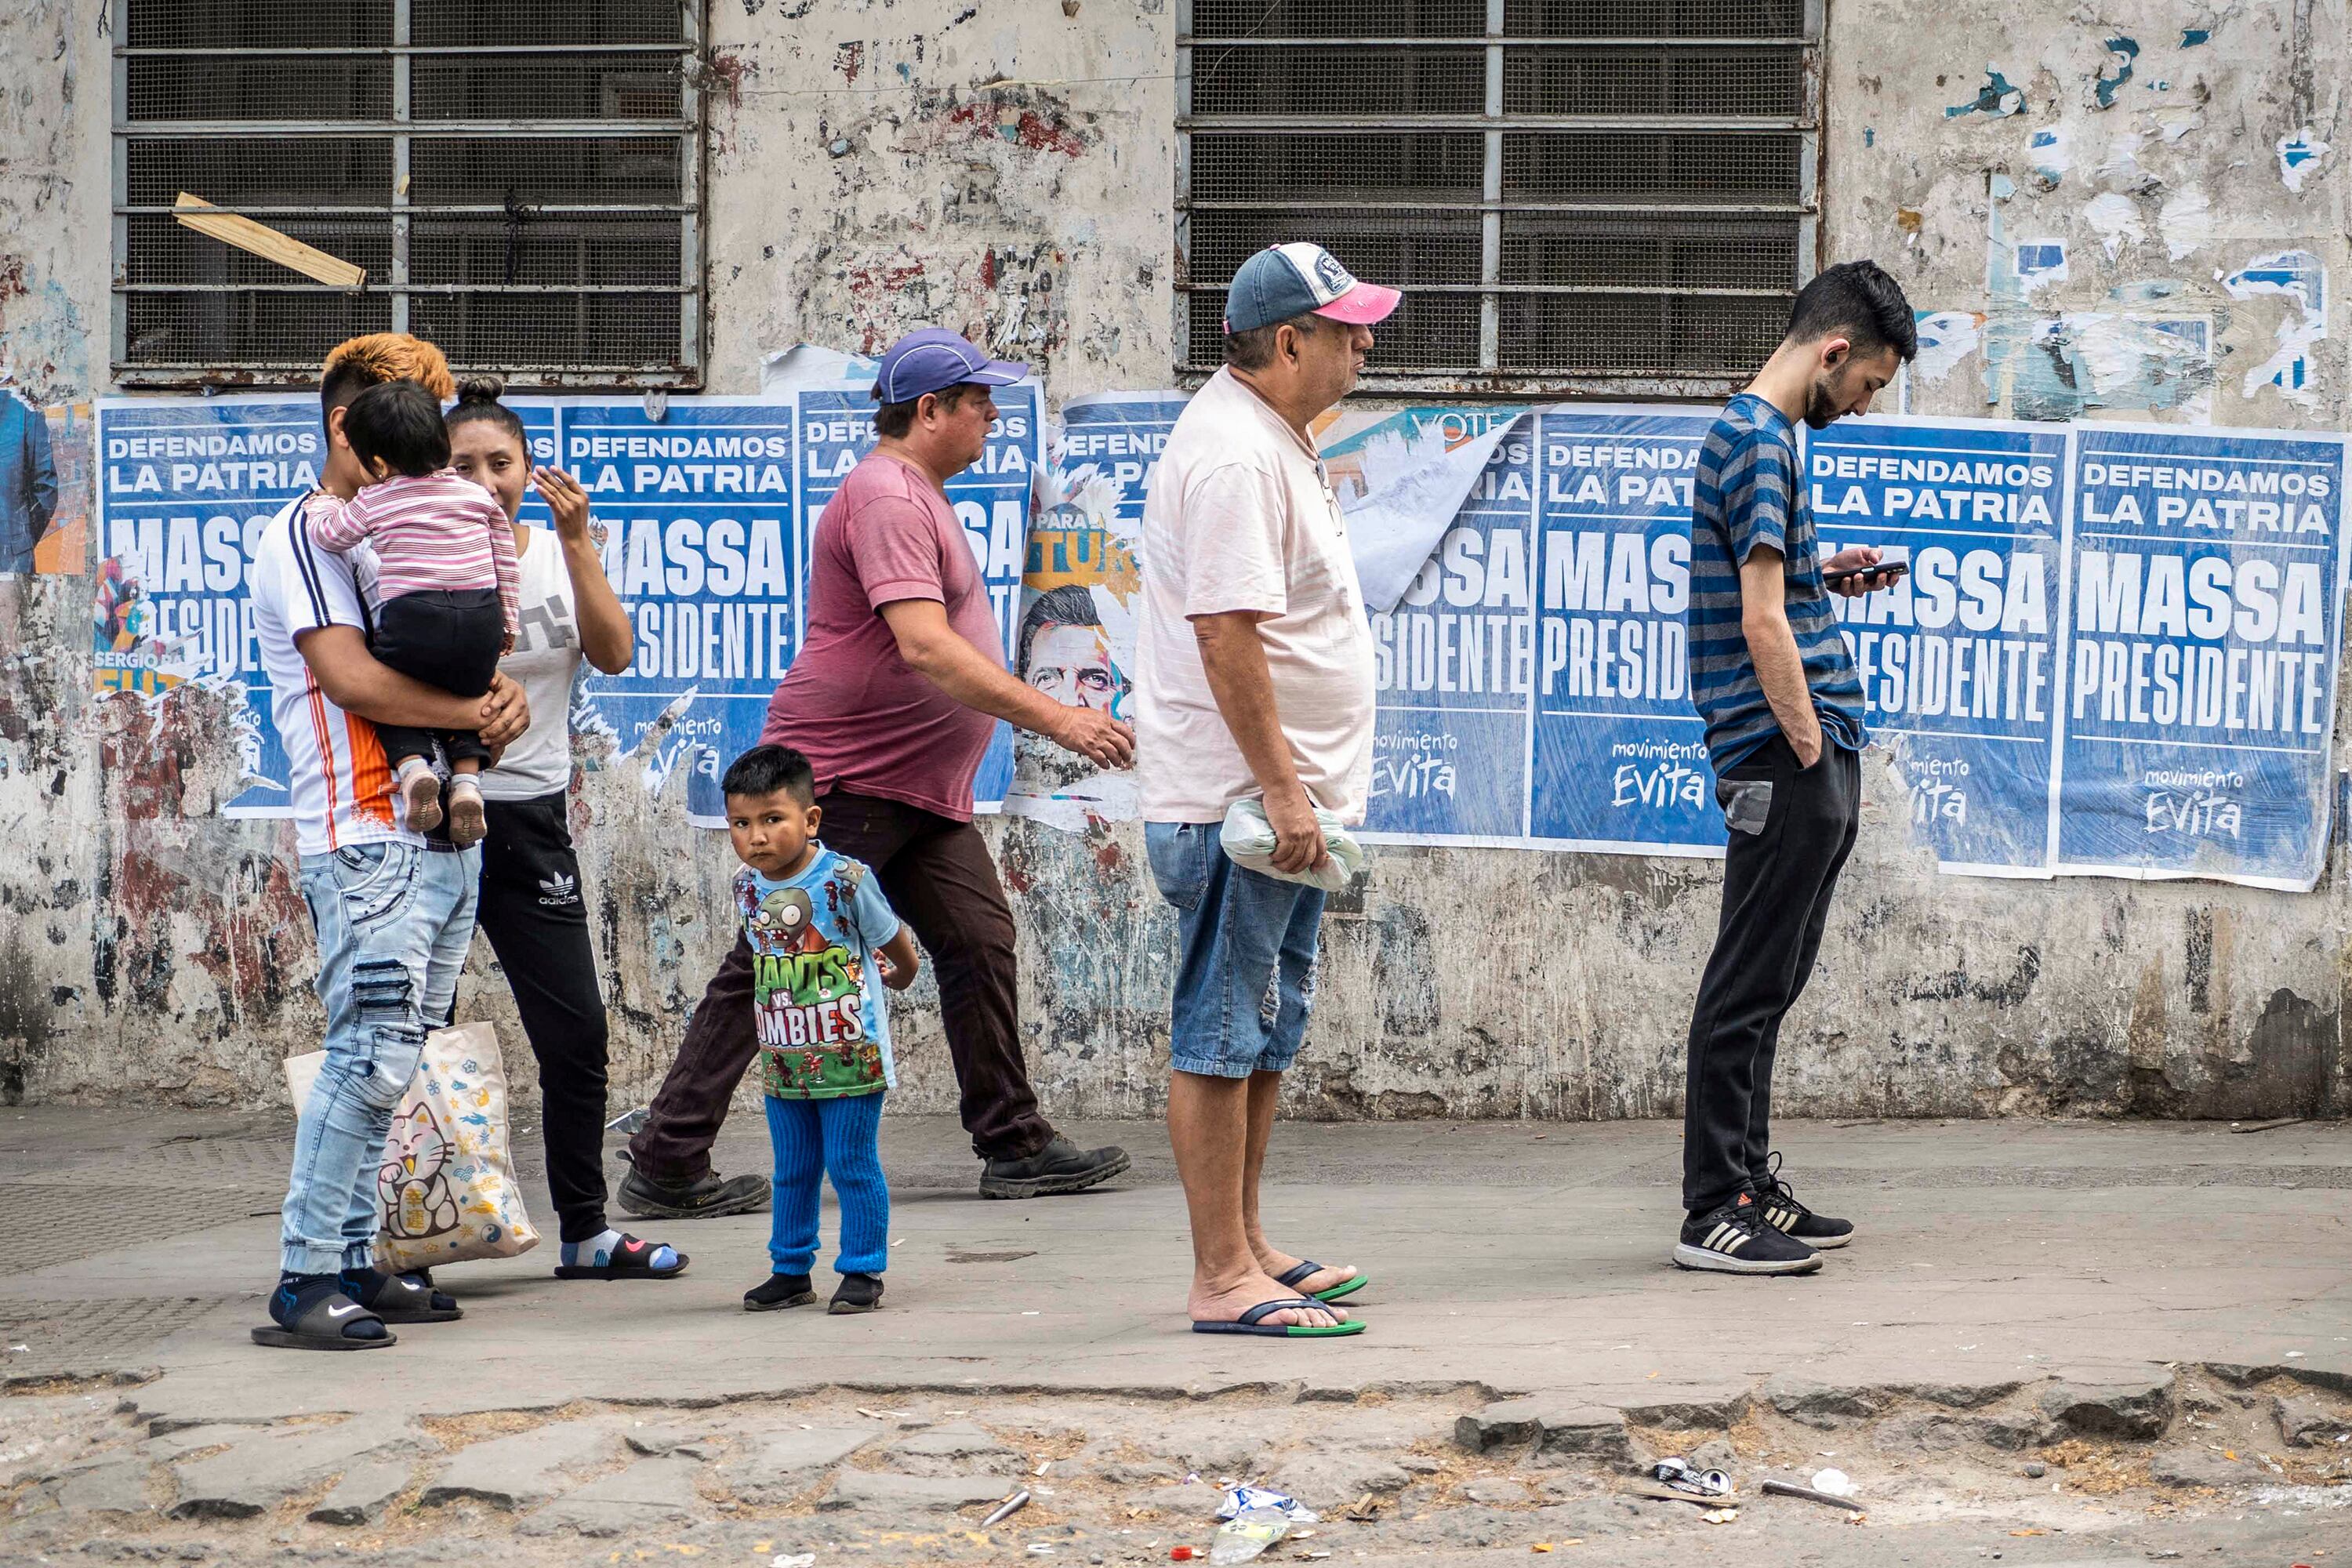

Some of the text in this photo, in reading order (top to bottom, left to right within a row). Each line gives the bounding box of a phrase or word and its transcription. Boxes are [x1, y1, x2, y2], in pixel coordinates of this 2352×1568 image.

[108, 433, 317, 459] DEFENDAMOS
[570, 437, 786, 459] DEFENDAMOS
[110, 460, 318, 493] LA PATRIA
[571, 464, 625, 493] LA
[634, 464, 787, 493] PATRIA
[1812, 455, 2054, 488] DEFENDAMOS
[2084, 463, 2331, 498] DEFENDAMOS
[1548, 473, 1608, 508] LA
[1811, 484, 2053, 525] LA PATRIA
[1036, 511, 1087, 530] PARA
[2082, 492, 2330, 535] LA PATRIA
[1544, 530, 1691, 614] MAS
[2077, 550, 2325, 645] MASSA
[94, 652, 158, 668] SERGIO
[1370, 612, 1529, 693] SIDENTE
[1542, 616, 1693, 701] PRESID
[2073, 639, 2325, 735] PRESIDENTE
[1612, 738, 1708, 760] movimiento
[2144, 765, 2244, 789] movimiento
[539, 895, 579, 905] adidas
[753, 944, 851, 990] LANTS
[754, 993, 863, 1046] OMBIES
